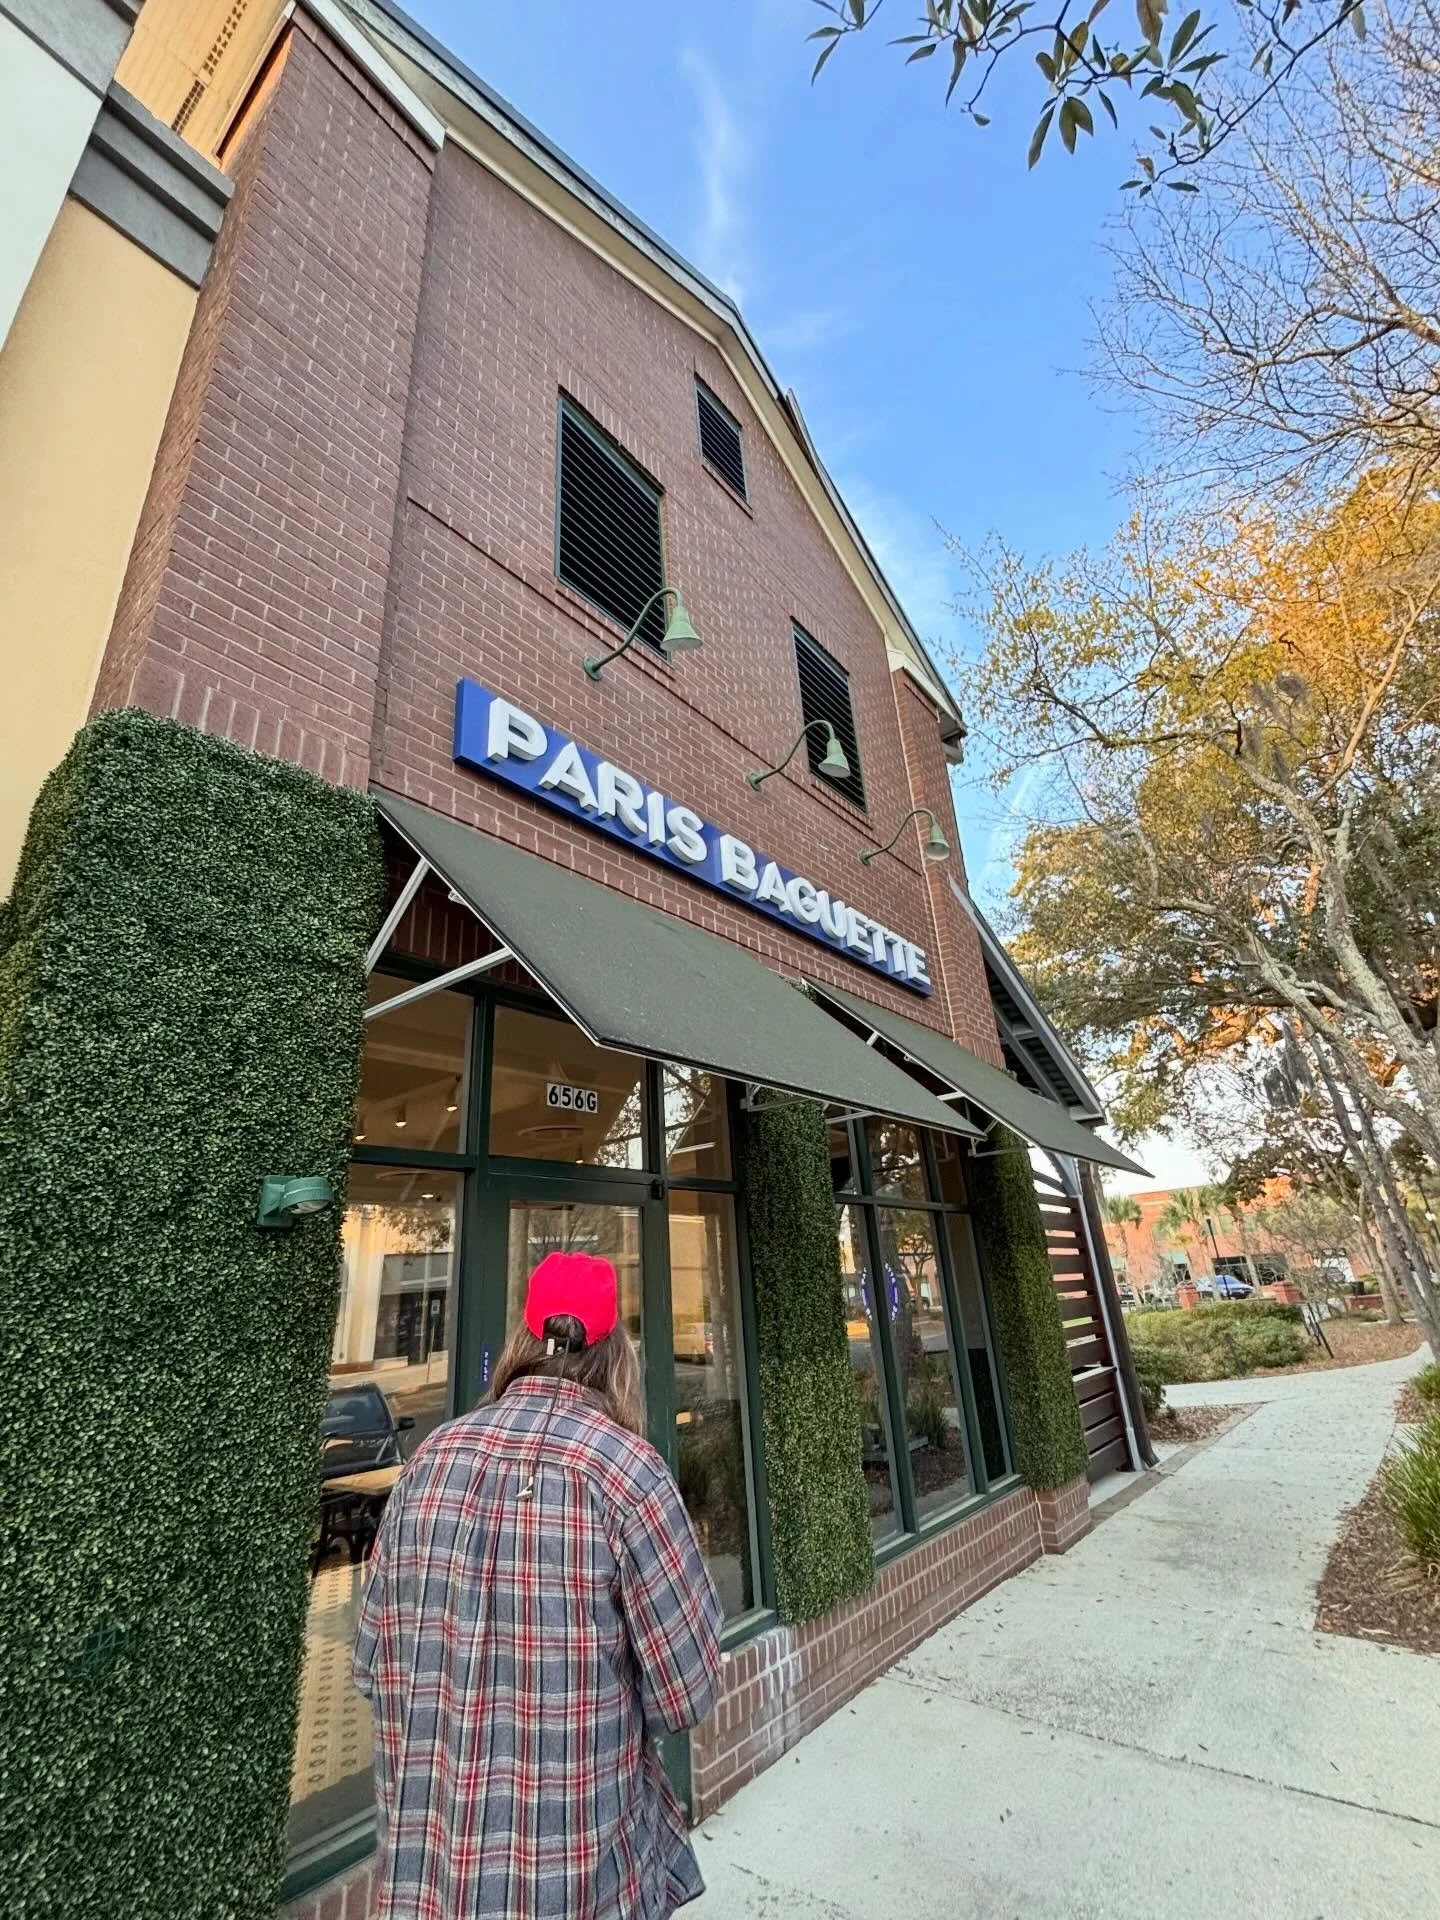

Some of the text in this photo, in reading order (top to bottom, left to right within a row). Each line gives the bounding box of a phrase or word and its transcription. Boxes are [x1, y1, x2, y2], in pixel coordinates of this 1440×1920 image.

[487, 697, 931, 985] PARIS BAGUETTE
[548, 1085, 597, 1111] 656G
